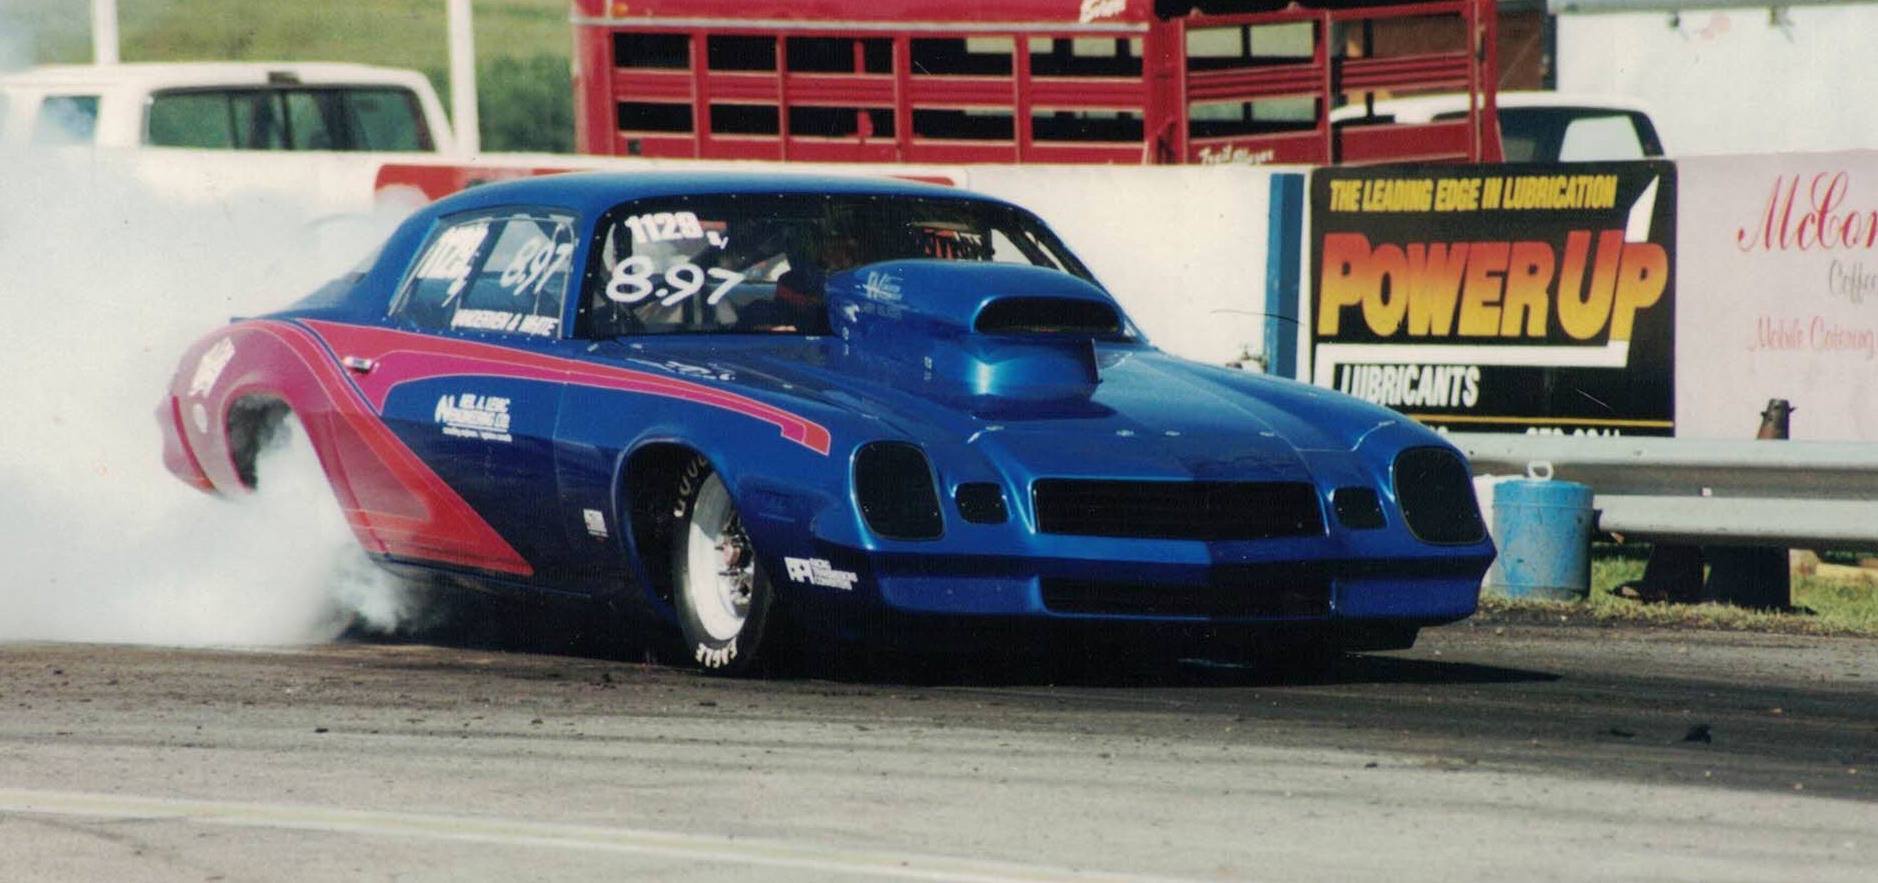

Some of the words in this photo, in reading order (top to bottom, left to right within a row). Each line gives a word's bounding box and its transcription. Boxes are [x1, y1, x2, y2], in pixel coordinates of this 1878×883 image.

[1330, 179, 1362, 212] THE
[1362, 179, 1434, 212] LEADING
[1433, 178, 1482, 212] EDGE
[1481, 177, 1503, 210] IN
[1502, 174, 1618, 210] LUBRICATION
[606, 255, 745, 307] 8.97
[1341, 364, 1481, 408] LUBRICANTS
[695, 636, 738, 669] EAGLE
